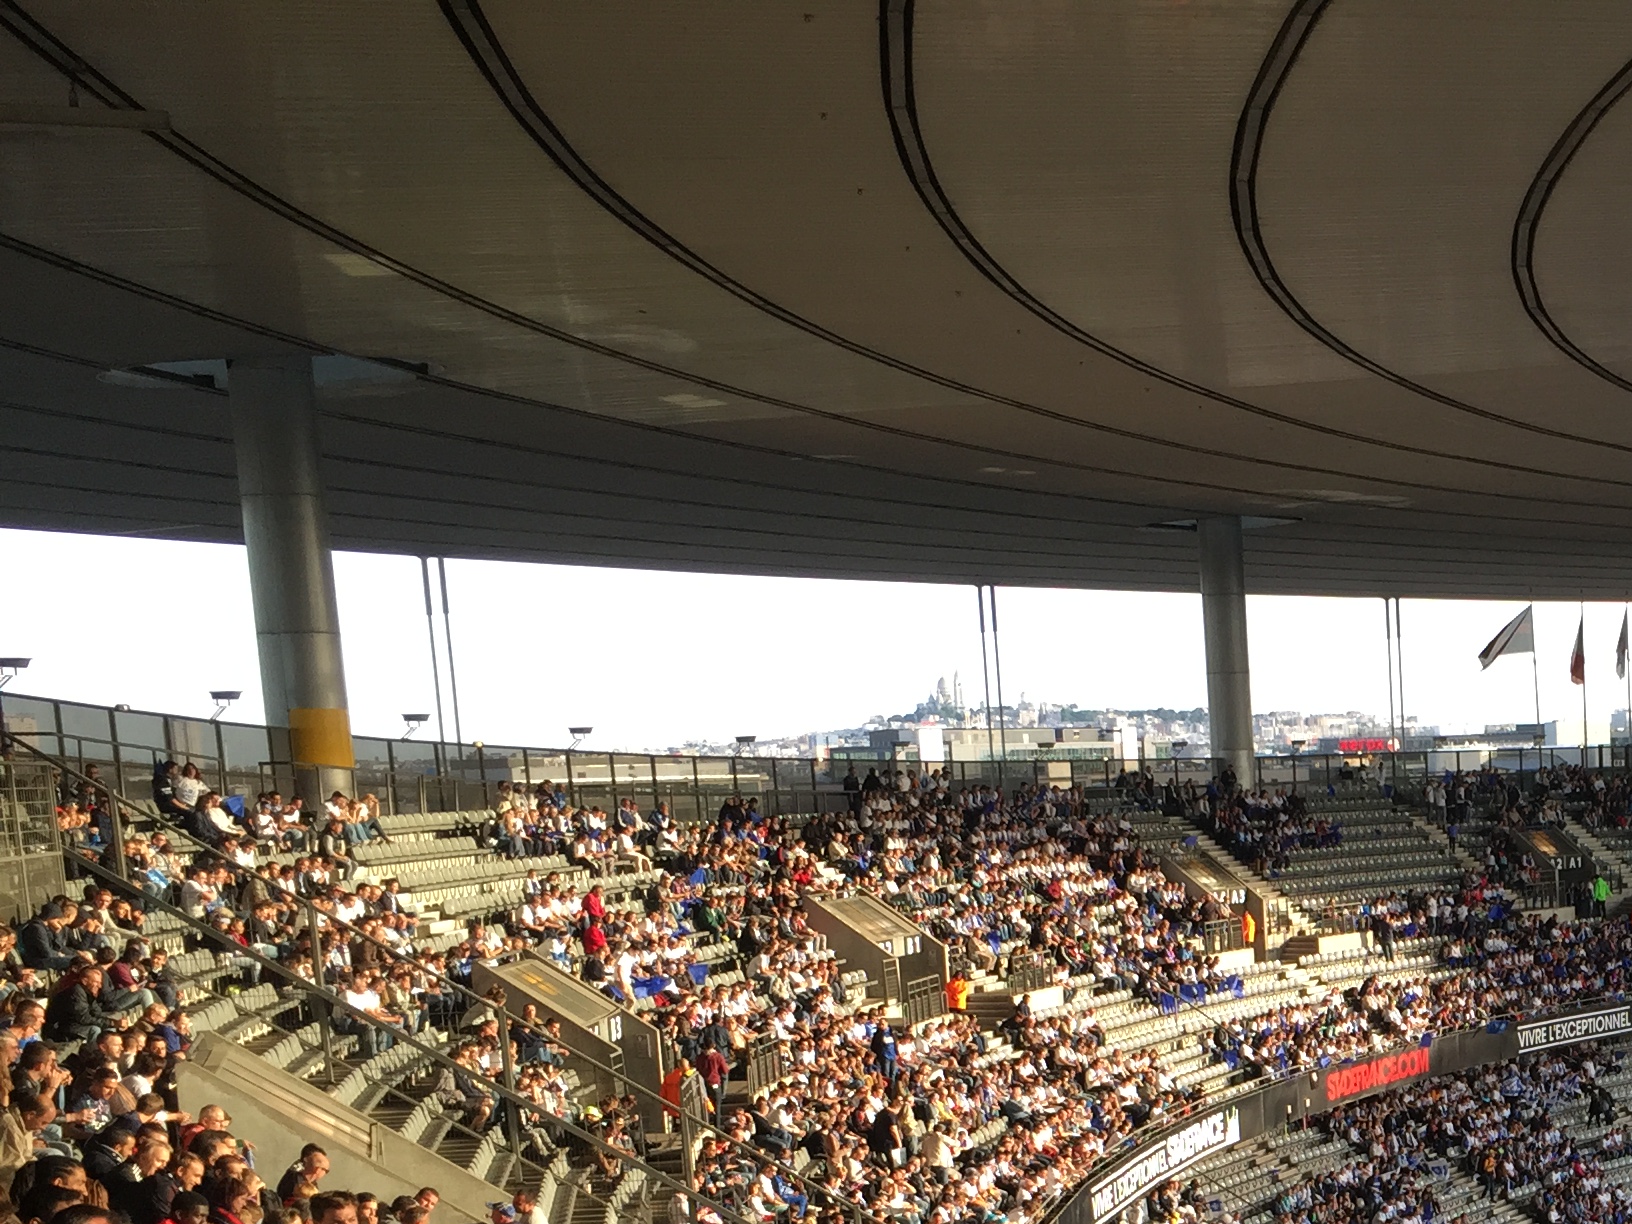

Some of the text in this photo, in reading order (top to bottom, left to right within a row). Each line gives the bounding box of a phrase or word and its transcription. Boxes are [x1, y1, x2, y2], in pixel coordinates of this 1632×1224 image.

[1569, 856, 1582, 869] A1
[1231, 889, 1246, 905] A3
[906, 935, 921, 955] B1
[610, 1015, 622, 1042] B3
[1518, 1026, 1547, 1048] VIVRE
[1548, 1012, 1632, 1044] L'EXCEPTIONNEL
